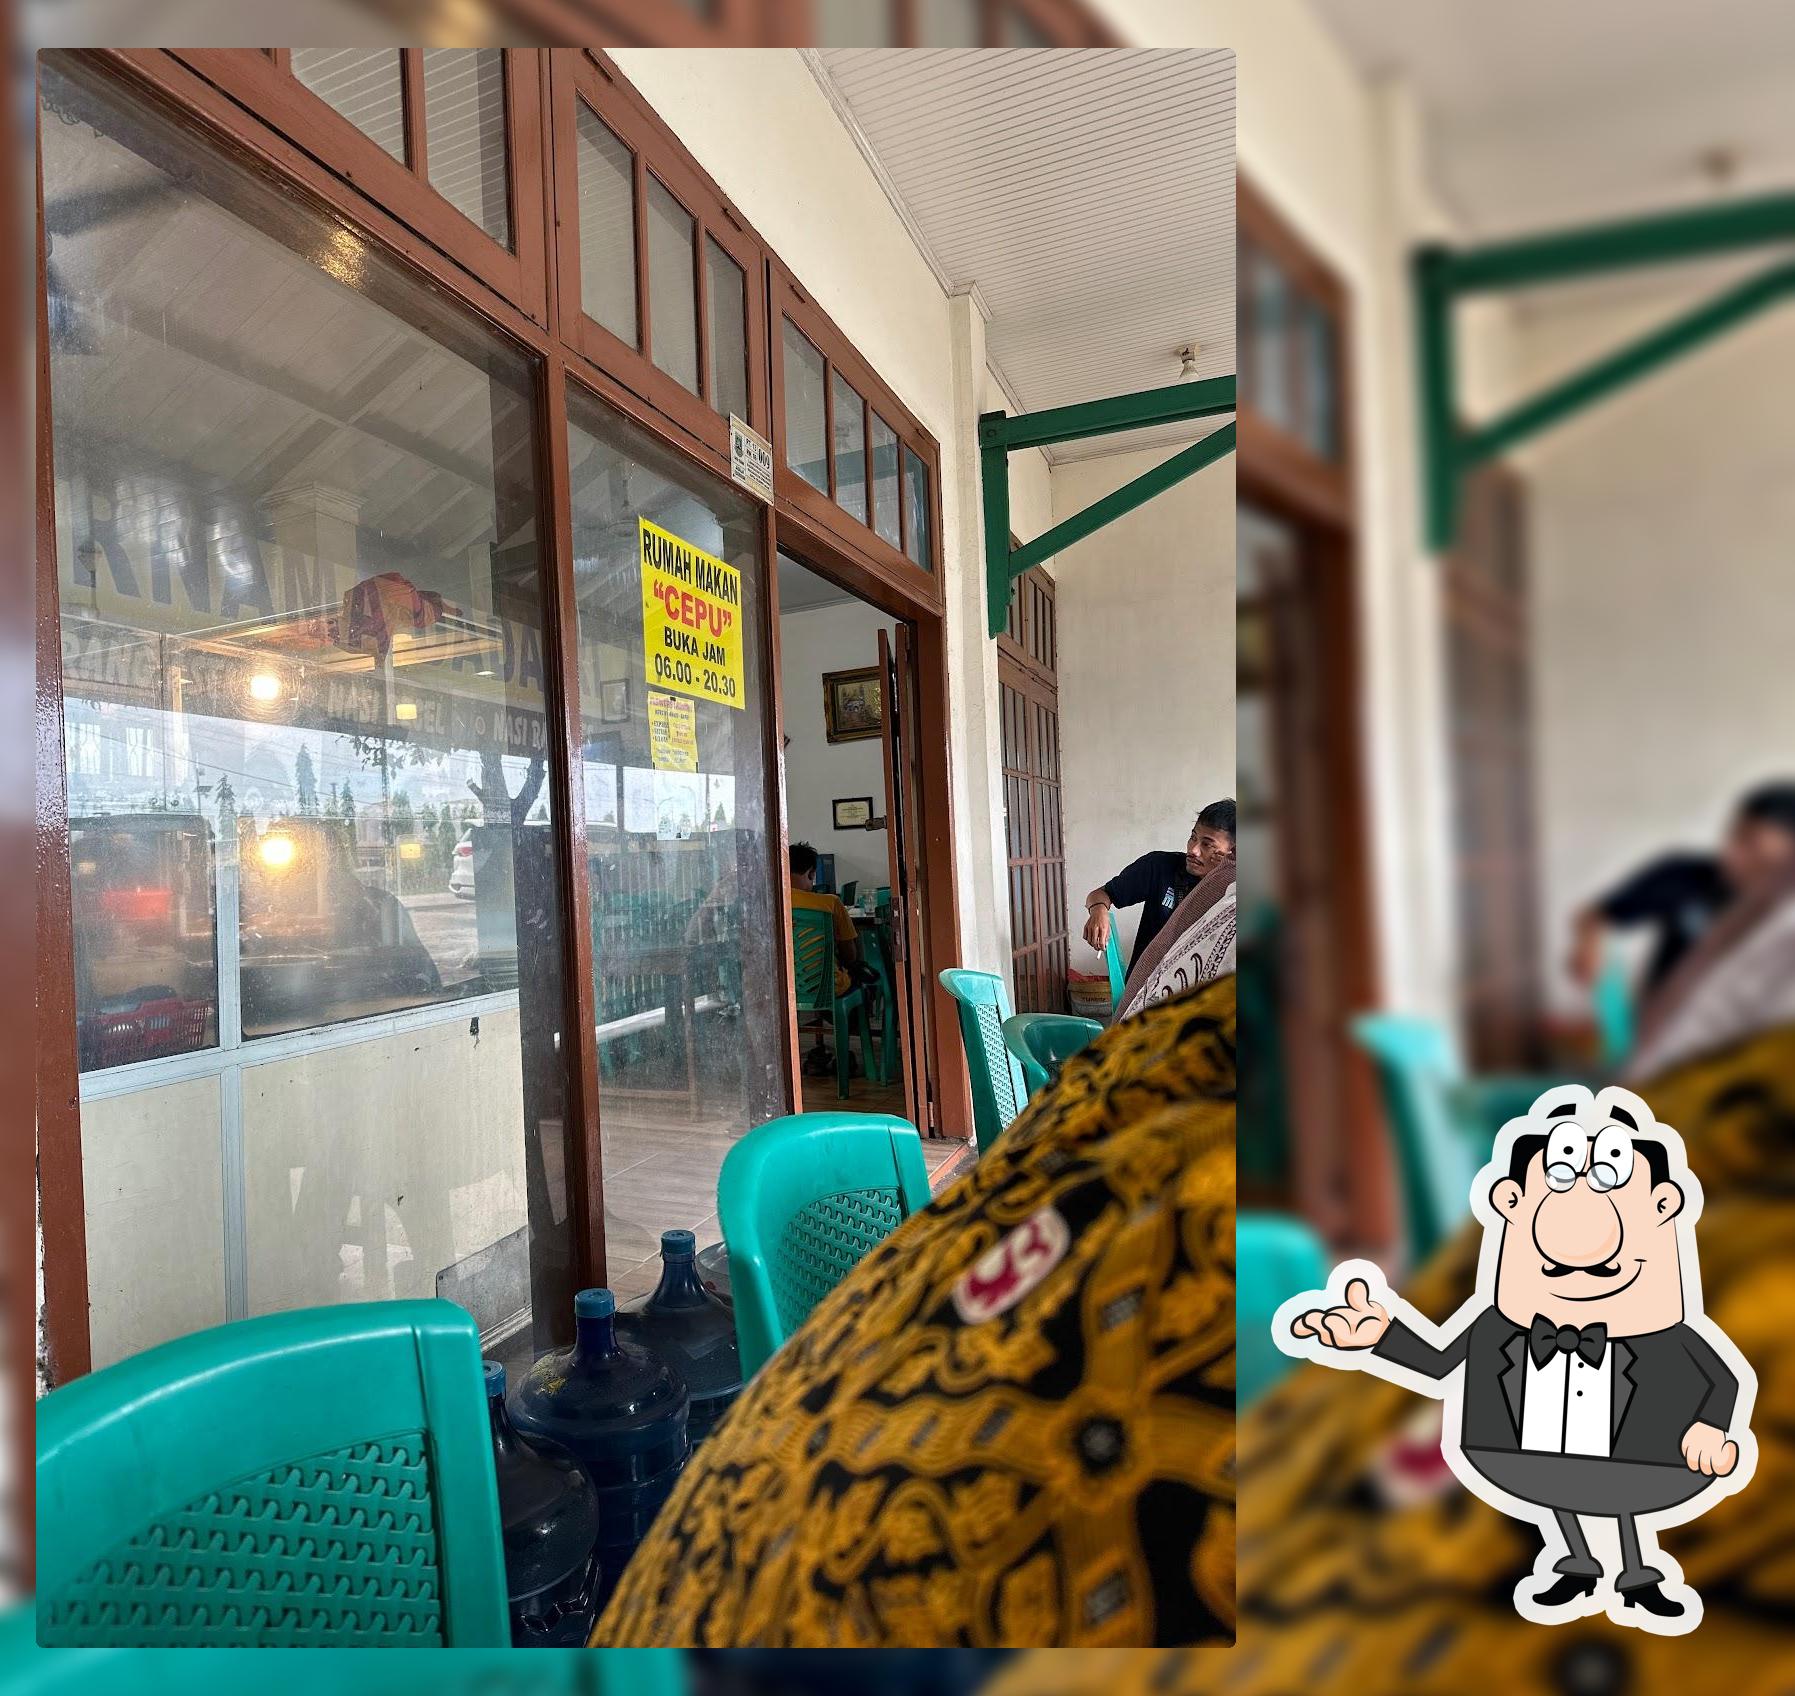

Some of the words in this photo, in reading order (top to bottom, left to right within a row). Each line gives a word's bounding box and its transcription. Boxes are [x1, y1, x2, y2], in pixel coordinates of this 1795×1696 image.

[643, 528, 691, 585] RUMAH
[695, 561, 738, 606] MAKAN
[664, 626, 699, 658] BUKA
[702, 643, 726, 667] JAM
[655, 653, 692, 685] 06.00
[703, 669, 736, 698] 20.30
